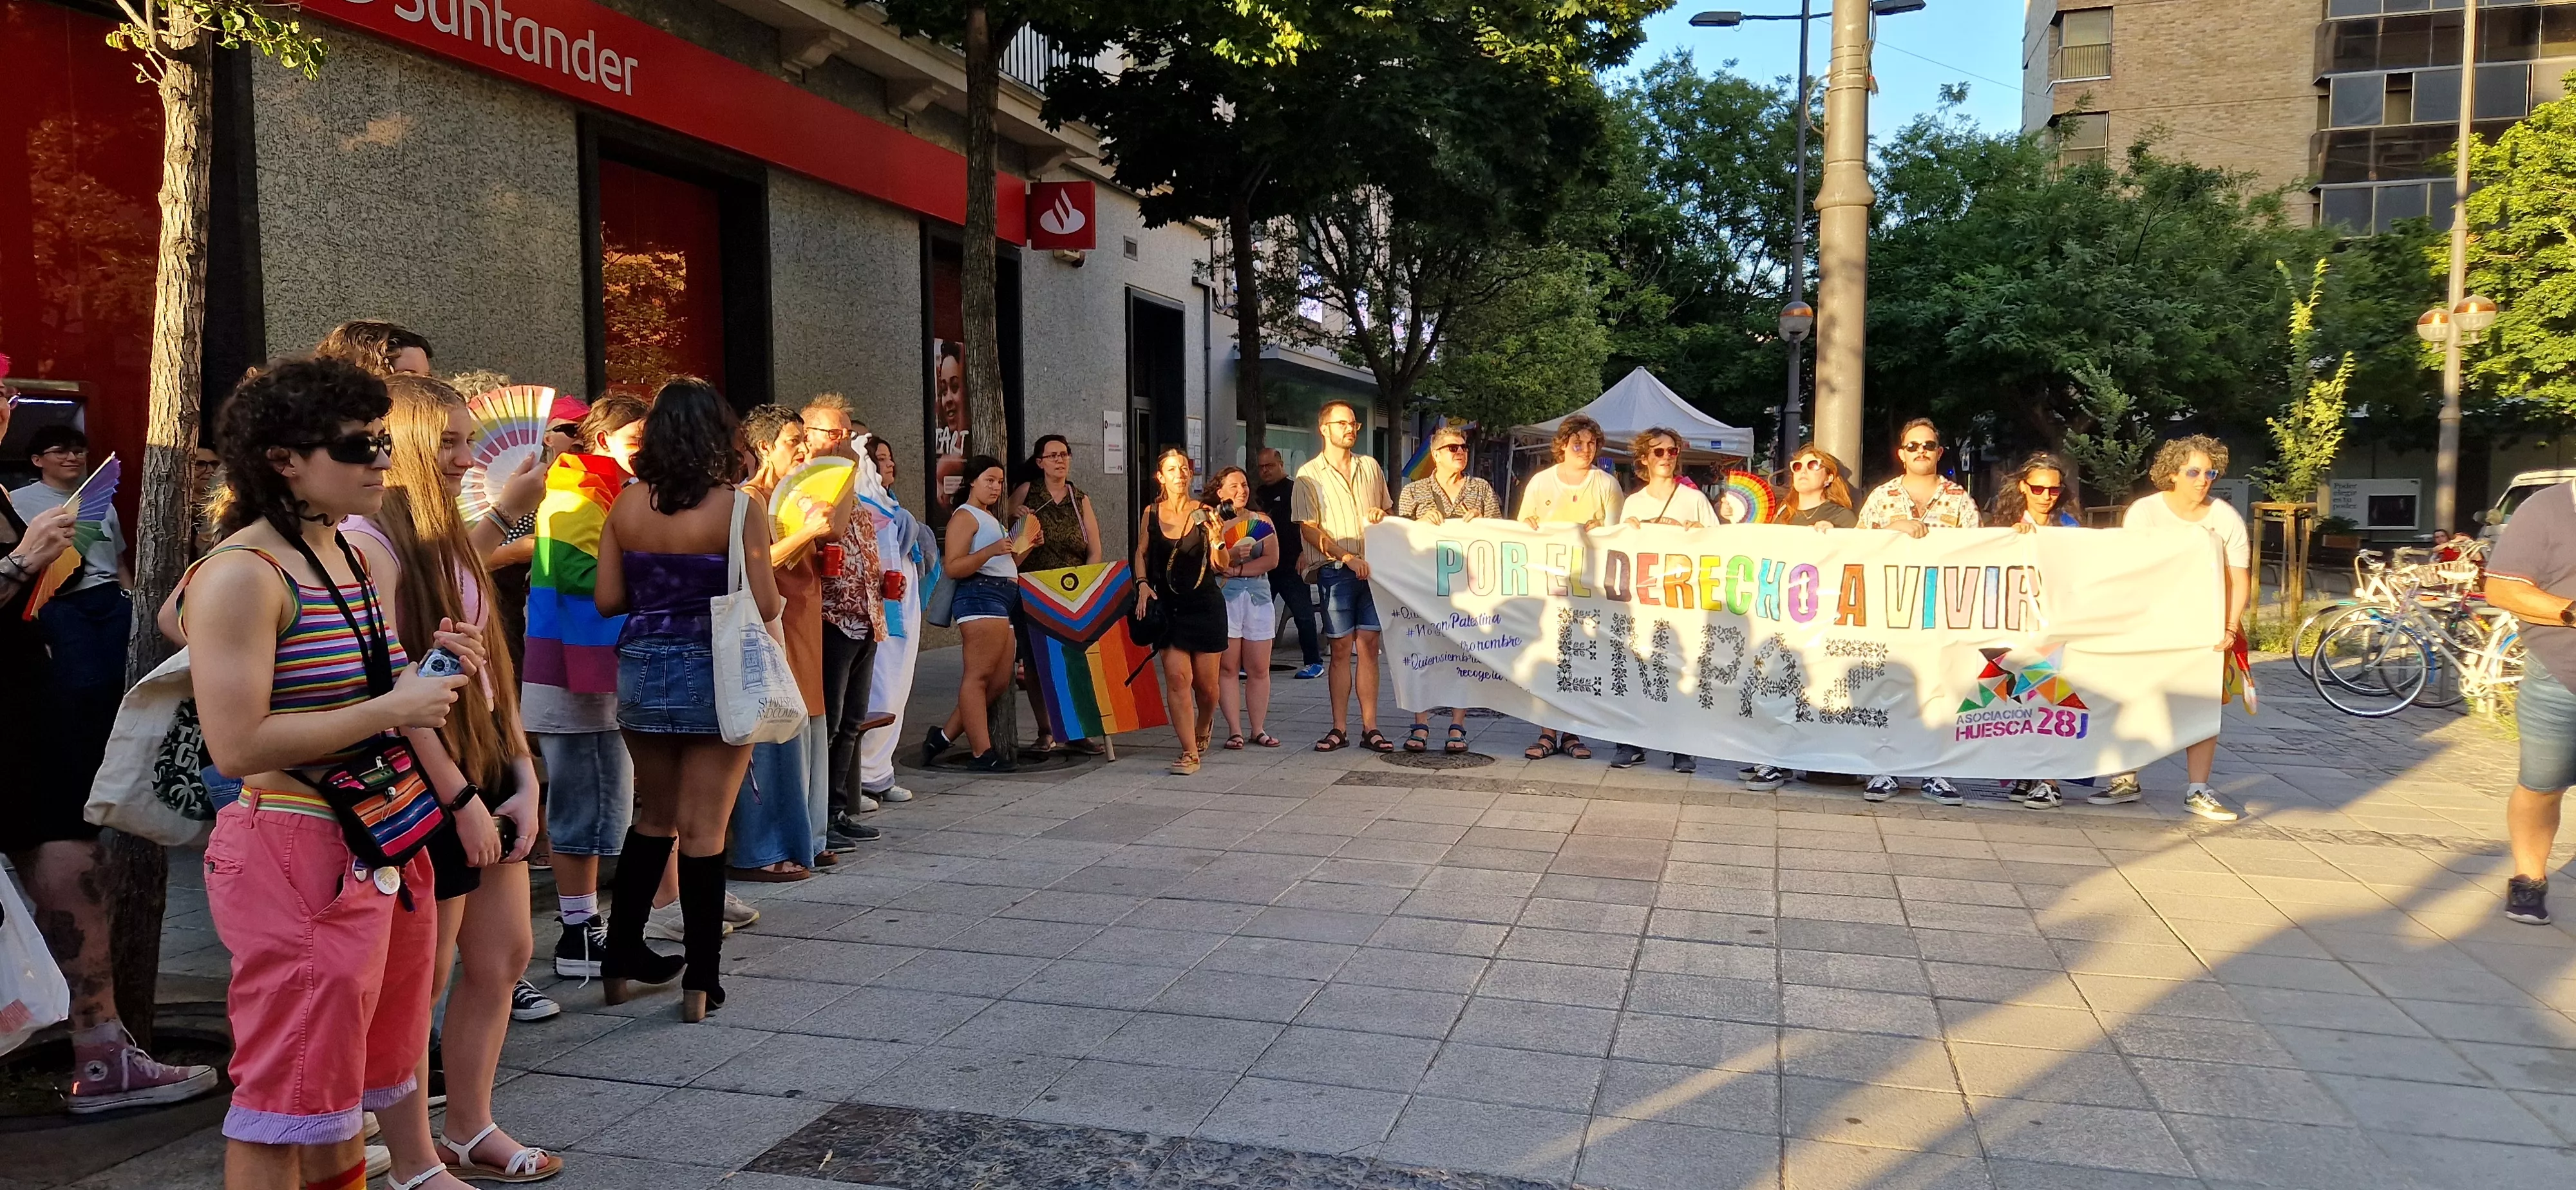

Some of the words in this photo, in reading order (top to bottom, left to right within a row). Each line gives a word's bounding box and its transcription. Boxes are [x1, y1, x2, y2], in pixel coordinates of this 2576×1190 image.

[1436, 539, 1529, 597] POR
[1546, 543, 1591, 598] EL
[1604, 549, 1819, 623] DERECHO
[1833, 563, 1867, 627] A
[1884, 565, 2043, 631] VIVIR
[1556, 607, 1669, 703] EN
[1698, 622, 1889, 729] PAZ
[1955, 719, 2034, 741] HUESCA
[2037, 706, 2089, 739] 28J
[1956, 706, 2032, 725] ASOCIACIÓN
